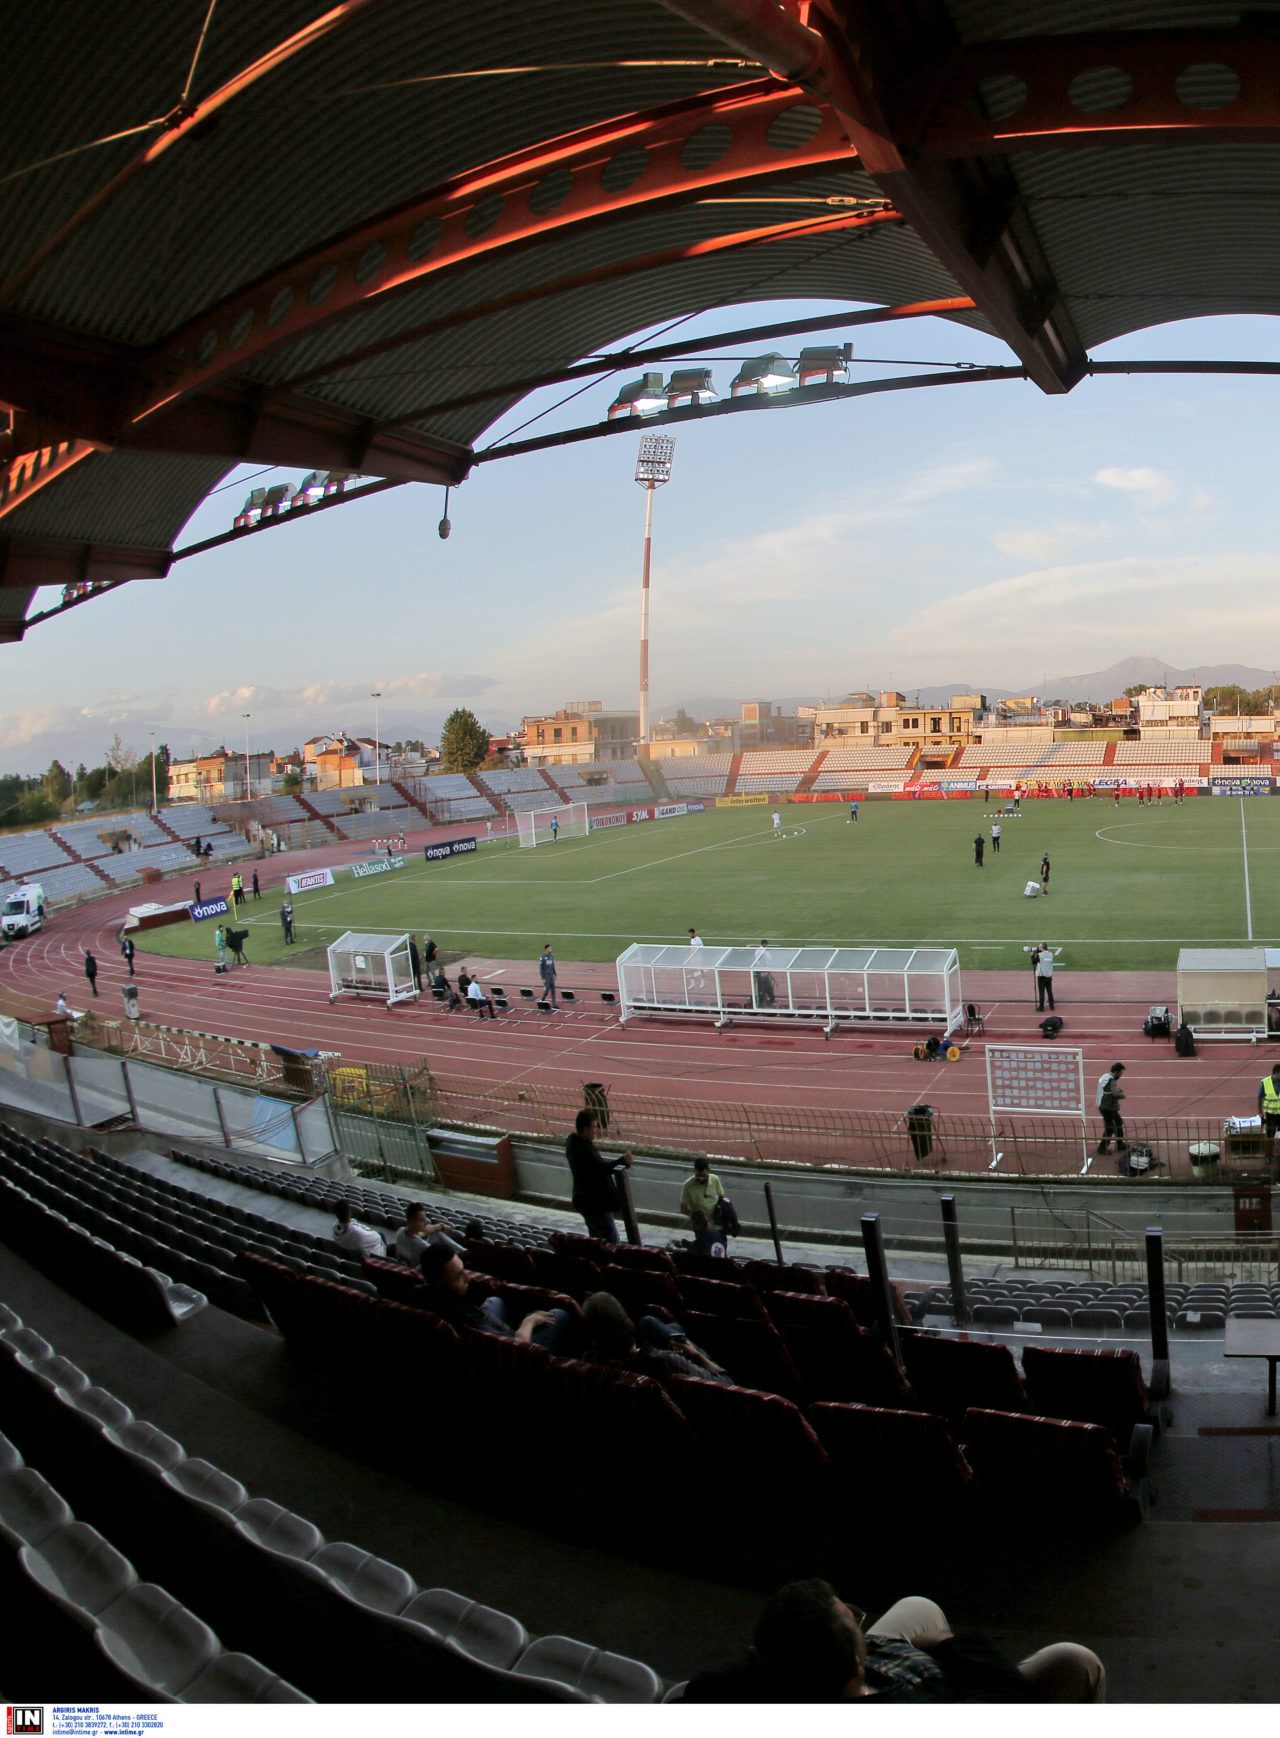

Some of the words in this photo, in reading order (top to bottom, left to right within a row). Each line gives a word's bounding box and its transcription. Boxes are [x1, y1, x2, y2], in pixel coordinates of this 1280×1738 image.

[632, 809, 649, 821] SYM
[459, 841, 476, 851] nova
[351, 859, 391, 878] Hellasod
[203, 901, 227, 916] nova
